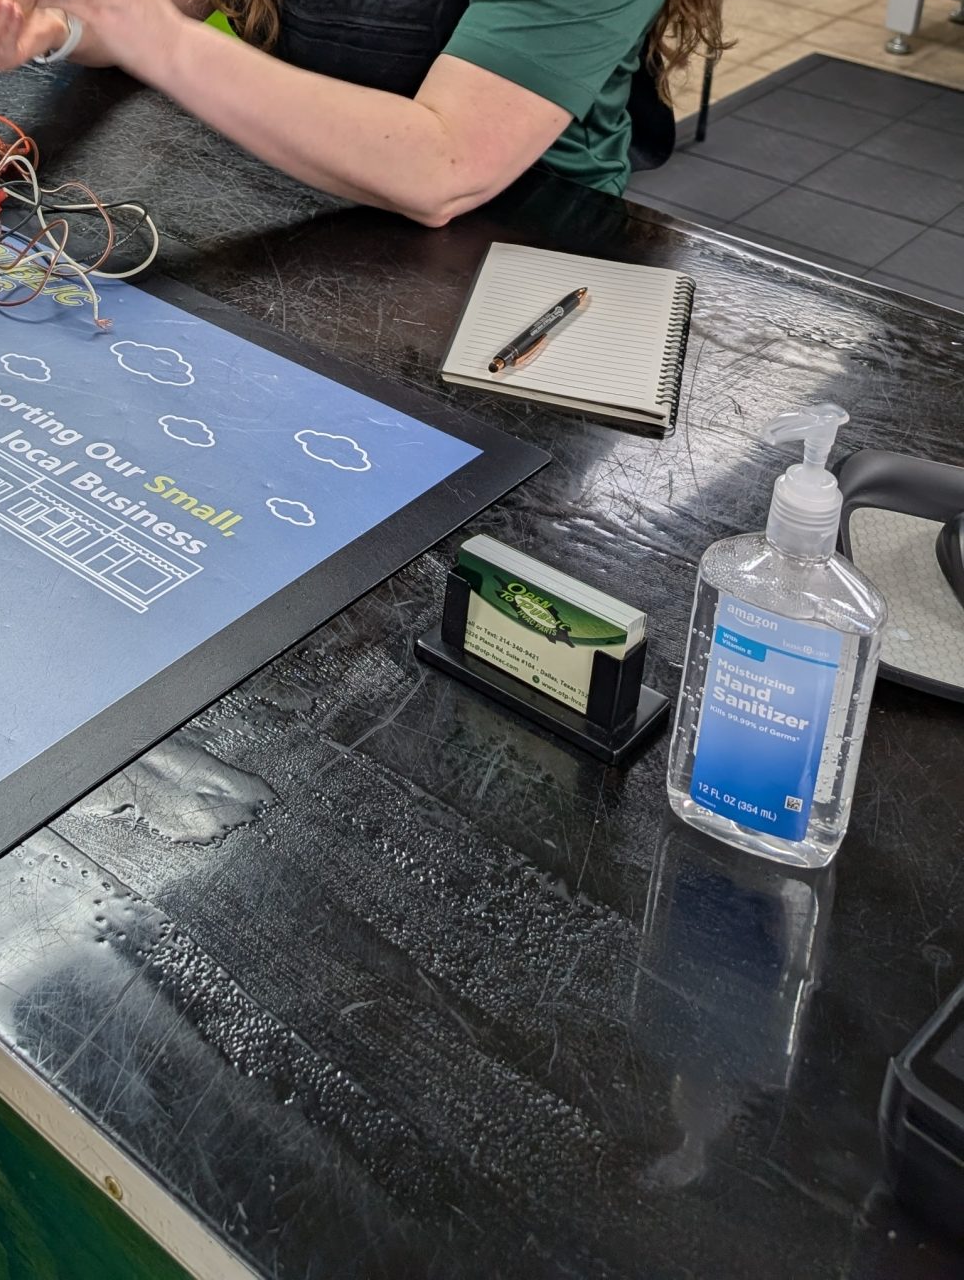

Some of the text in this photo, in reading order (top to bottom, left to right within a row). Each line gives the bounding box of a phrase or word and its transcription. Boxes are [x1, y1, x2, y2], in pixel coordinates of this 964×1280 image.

[85, 442, 147, 477] Our
[143, 475, 244, 538] Small,
[70, 471, 208, 555] Business
[507, 582, 553, 610] OPEN
[517, 597, 572, 632] PUBLIC
[518, 609, 557, 637] HVAC PARTS
[726, 603, 778, 631] amazon
[483, 628, 498, 640] Text:
[499, 635, 539, 662] 214-340-9421
[722, 638, 746, 653] Vitamin
[723, 631, 738, 643] With
[479, 637, 495, 649] Plano
[506, 650, 520, 663] Suite
[521, 658, 535, 670] #104
[560, 679, 577, 692] Texas
[718, 658, 796, 695] Moisturizing
[715, 670, 771, 703] Hand
[710, 704, 726, 719] Kills
[727, 713, 757, 729] 99.99%
[758, 724, 768, 732] of
[713, 686, 809, 731] Sanitizer
[698, 781, 709, 795] 12
[710, 788, 721, 801] FL
[723, 793, 736, 807] OZ
[737, 800, 758, 816] (354
[759, 807, 778, 823] mL)
